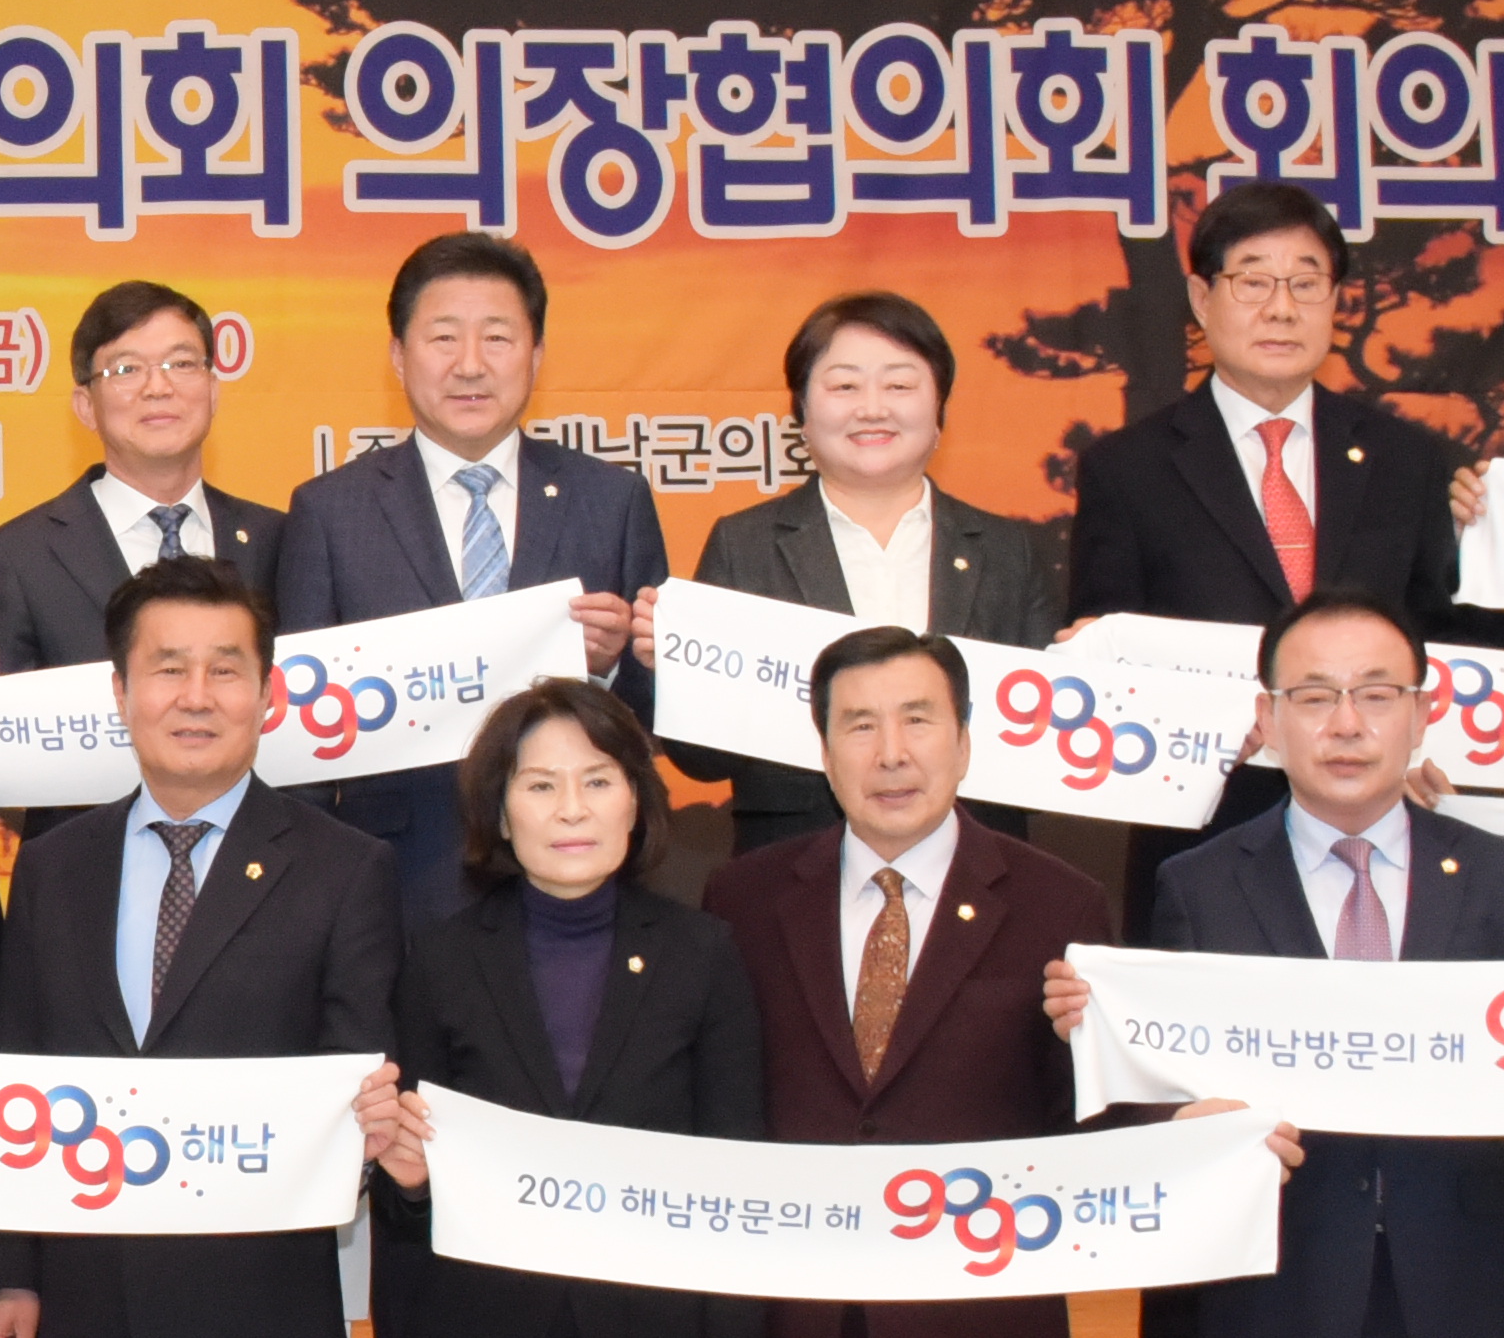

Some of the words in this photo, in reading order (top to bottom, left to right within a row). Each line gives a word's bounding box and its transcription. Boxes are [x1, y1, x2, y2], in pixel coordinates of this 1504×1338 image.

[355, 27, 1156, 239] 의장협의회
[403, 656, 489, 702] 해남
[663, 632, 743, 679] 2020
[1125, 1018, 1211, 1056] 2020
[1225, 1023, 1415, 1071] 해남방문의
[1428, 1032, 1465, 1064] 해
[180, 1121, 275, 1174] 해남
[517, 1173, 607, 1213] 2020
[620, 1184, 811, 1236] 해남방문의
[824, 1201, 862, 1233] 해
[1072, 1181, 1168, 1234] 해남
